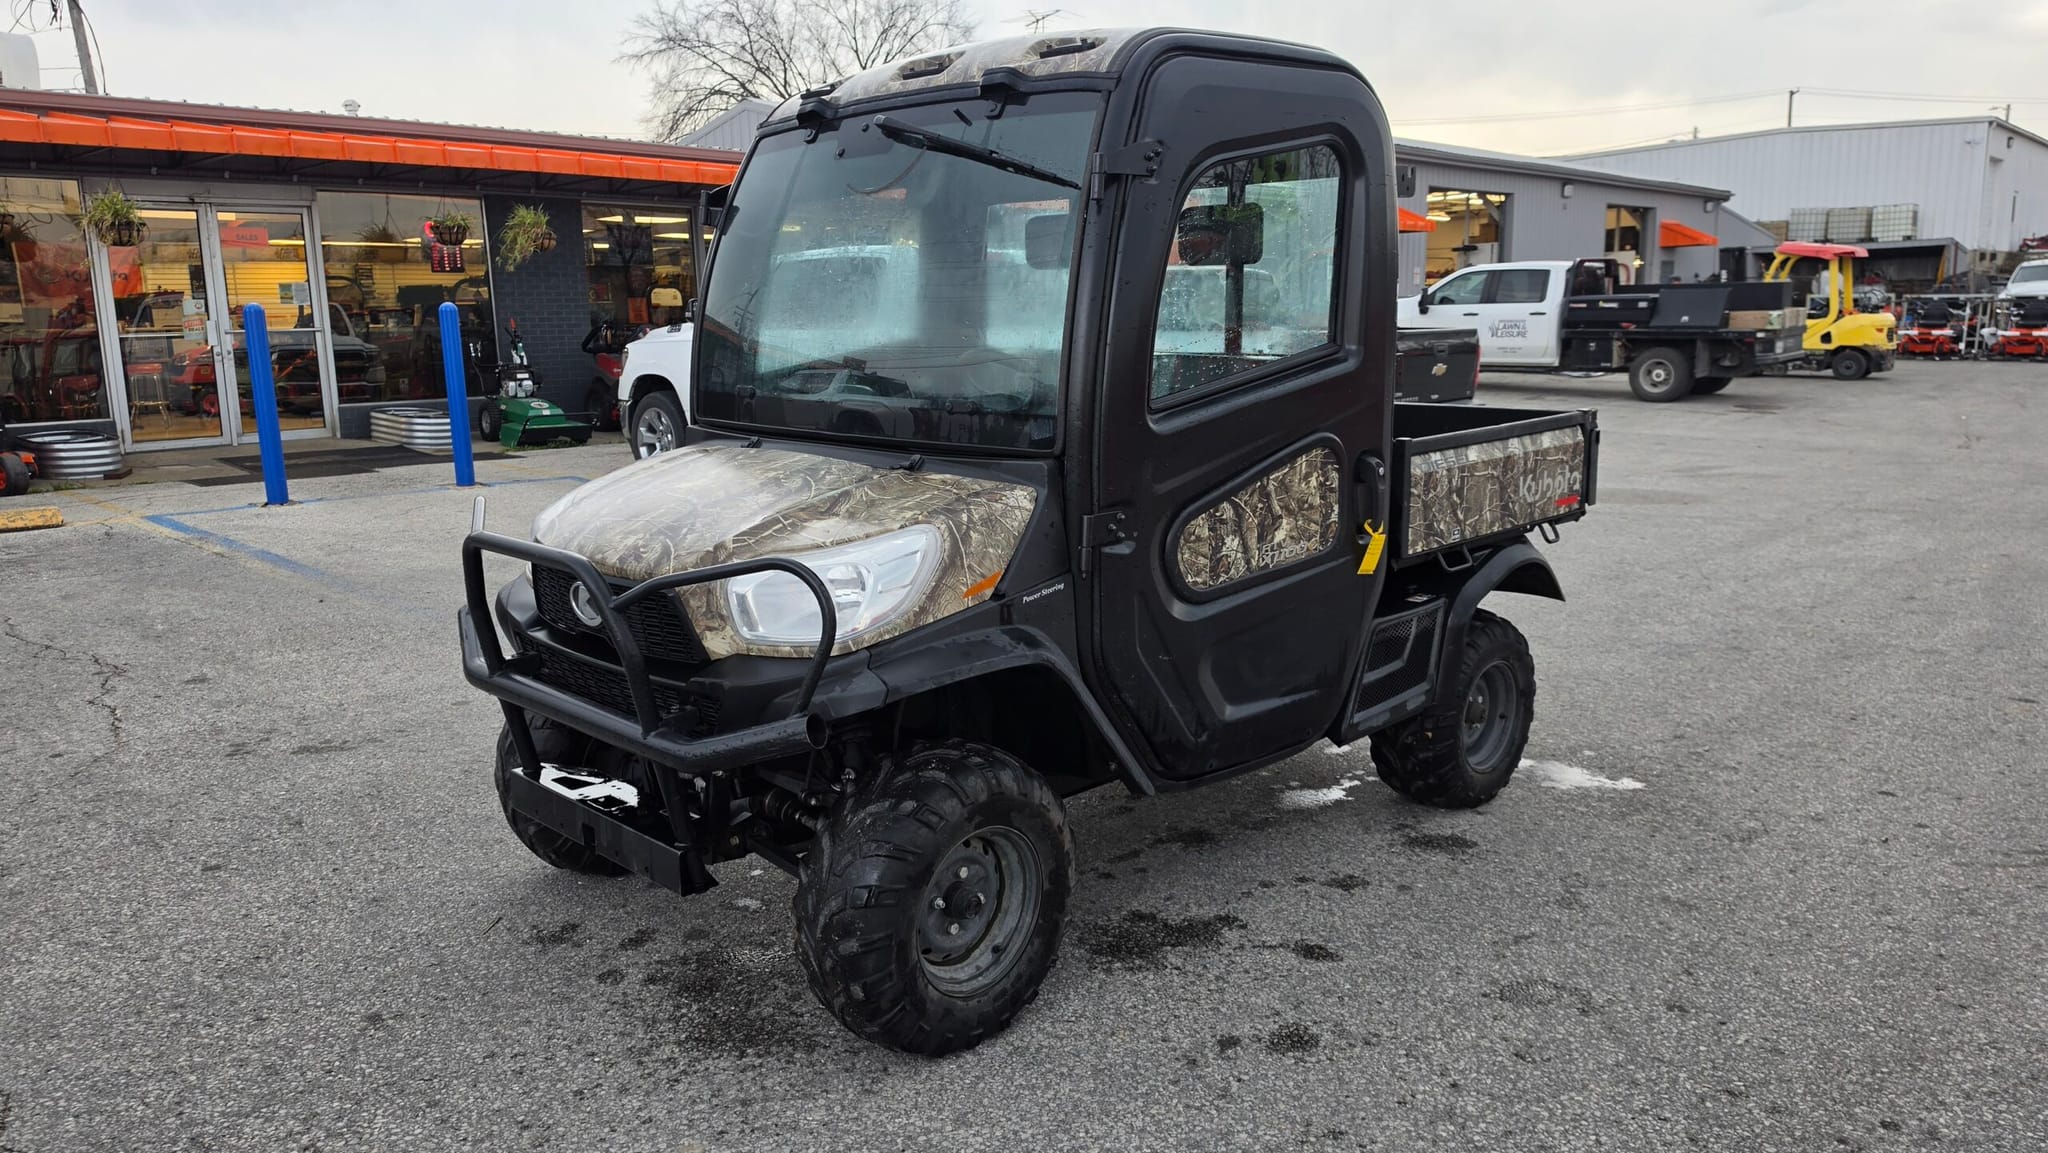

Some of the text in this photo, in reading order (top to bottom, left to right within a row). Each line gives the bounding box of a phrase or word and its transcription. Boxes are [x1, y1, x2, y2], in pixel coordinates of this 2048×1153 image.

[236, 233, 258, 241] SALES
[1496, 330, 1528, 338] LEISURE
[1519, 465, 1581, 503] Kubota
[1022, 582, 1065, 605] Power Steering
